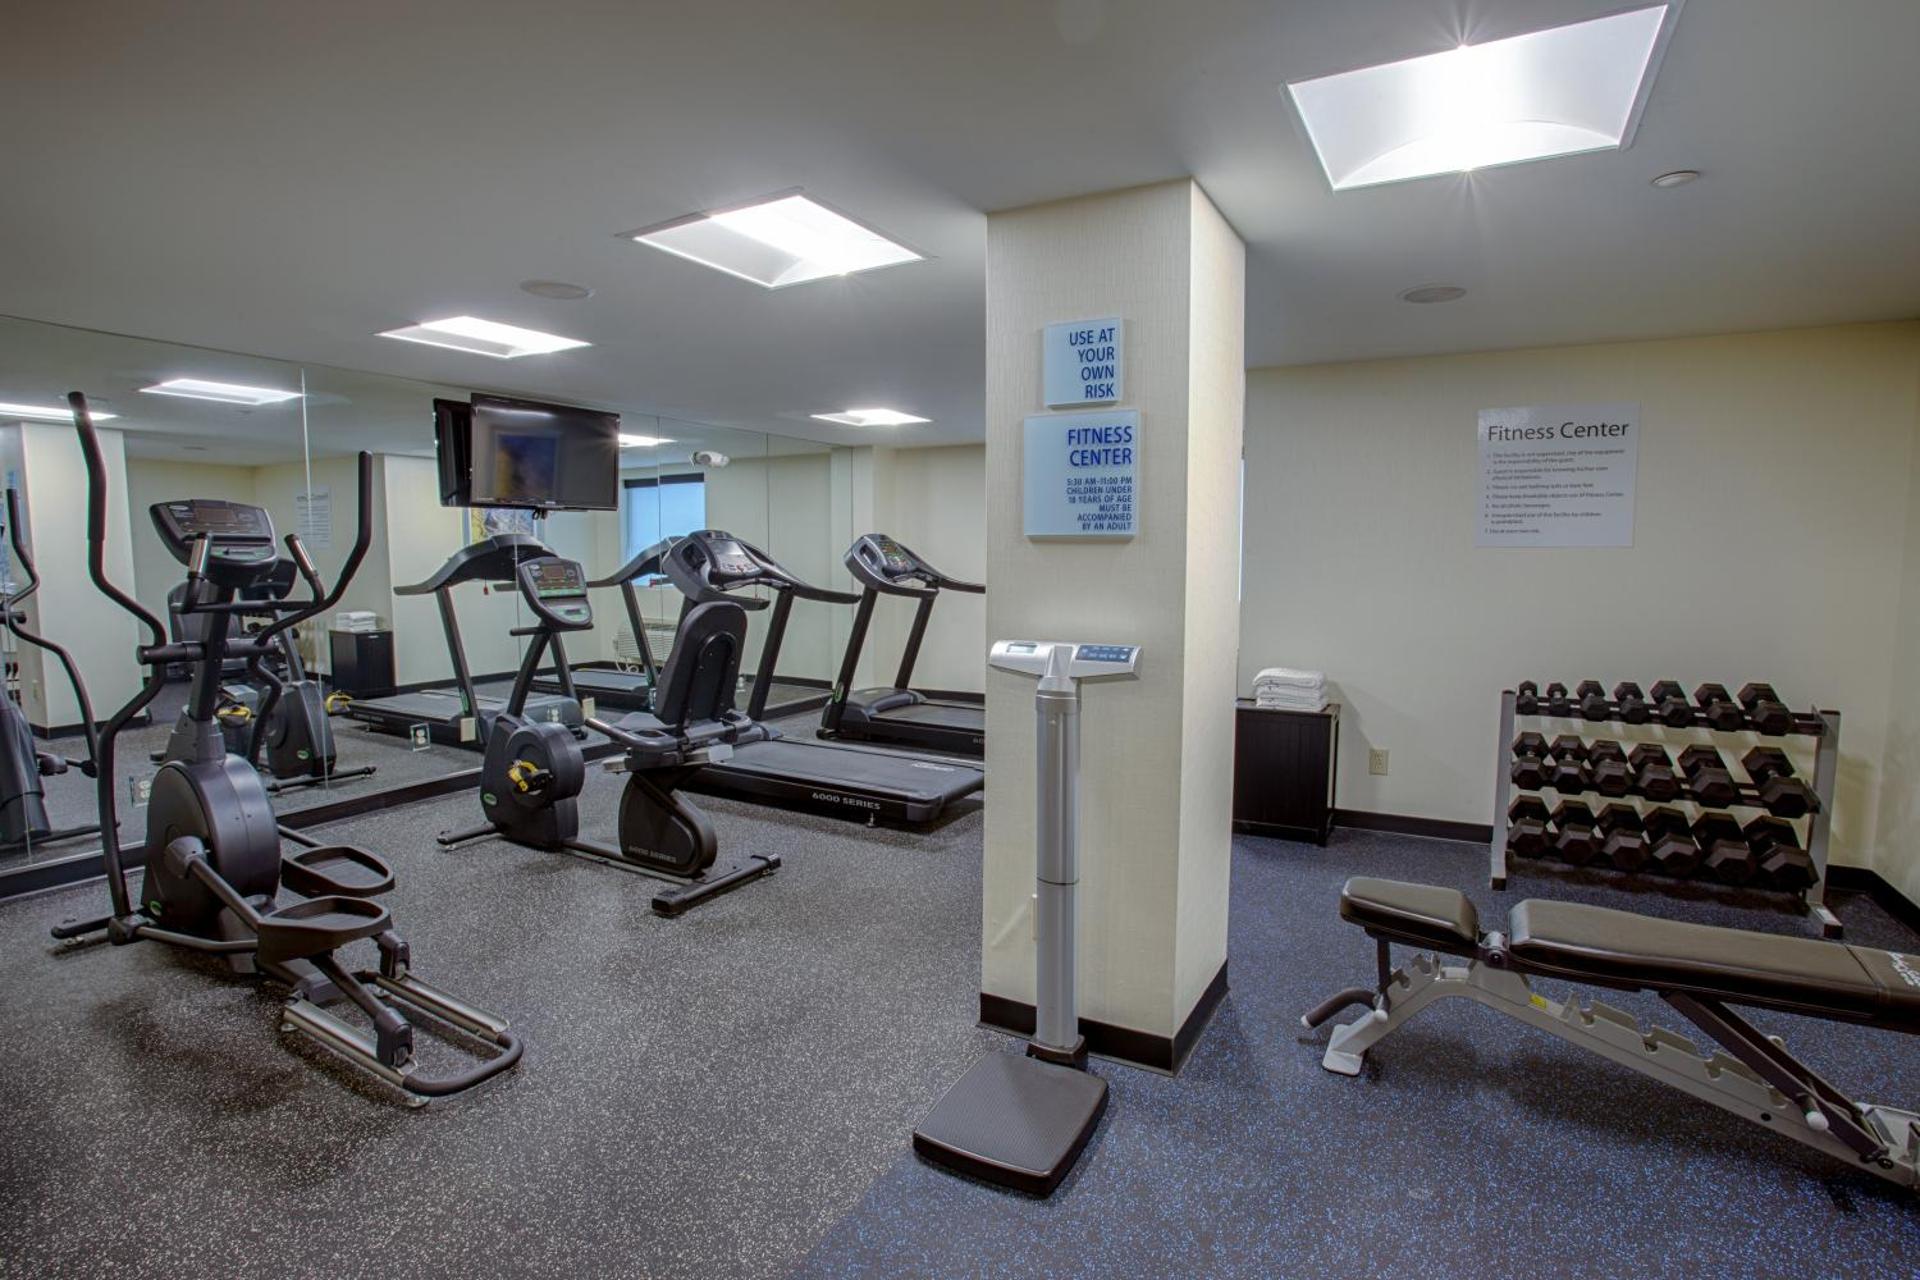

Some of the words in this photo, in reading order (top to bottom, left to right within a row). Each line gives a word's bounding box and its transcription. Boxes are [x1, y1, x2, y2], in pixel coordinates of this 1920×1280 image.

[1069, 329, 1094, 346] USE
[1099, 327, 1115, 342] AT
[1077, 346, 1115, 363] YOUR
[1081, 364, 1115, 381] OWN
[1085, 383, 1115, 399] RISK
[1068, 425, 1133, 446] FITNESS
[1488, 425, 1555, 441] Fitness
[1560, 421, 1629, 439] Center
[1069, 447, 1132, 467] CENTER
[1120, 476, 1132, 485] PM
[1066, 486, 1103, 495] CHILDREN
[1105, 485, 1132, 494] UNDER
[1078, 495, 1102, 504] YEARS
[1103, 495, 1115, 503] OF
[1116, 494, 1132, 503] AGE
[1099, 504, 1120, 513] MUST
[1122, 504, 1132, 512] BE
[1077, 513, 1132, 522] ACCOMPANIED
[1082, 522, 1091, 531] BY
[1094, 522, 1104, 531] AN
[1106, 521, 1132, 531] ADULT
[812, 791, 840, 804] 6000
[842, 797, 881, 810] SERIES
